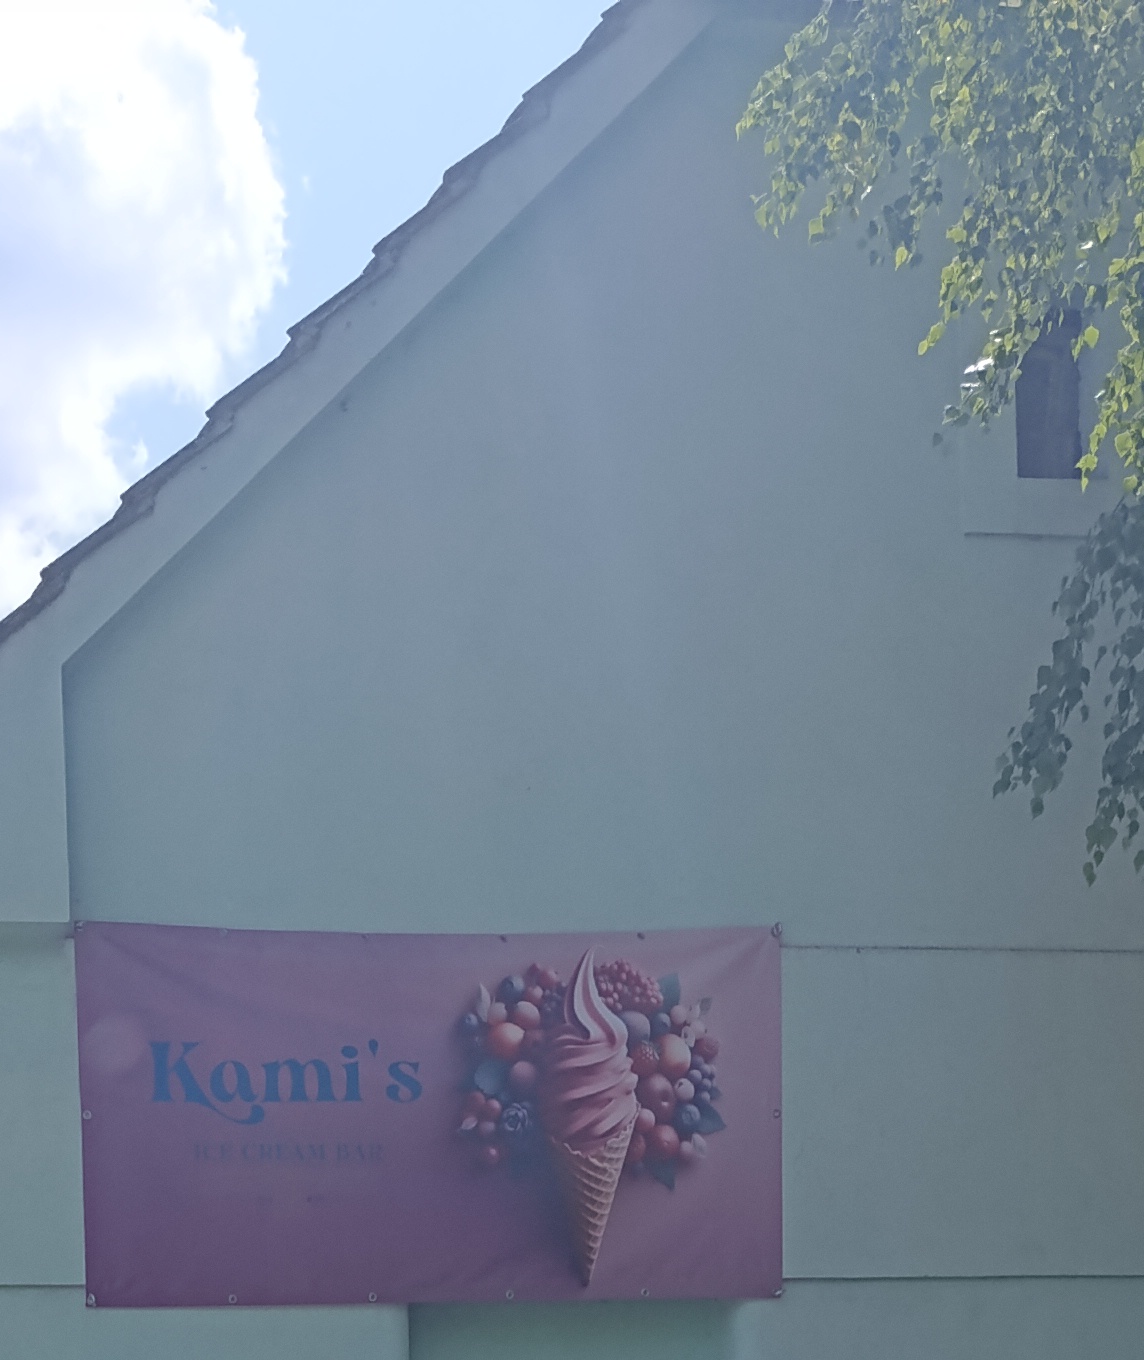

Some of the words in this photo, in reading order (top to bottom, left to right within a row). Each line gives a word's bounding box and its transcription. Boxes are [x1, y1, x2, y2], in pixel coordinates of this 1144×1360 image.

[148, 1038, 423, 1126] Kami's
[193, 1142, 233, 1162] ICE
[240, 1142, 326, 1163] CREAM
[335, 1142, 385, 1163] BAR
